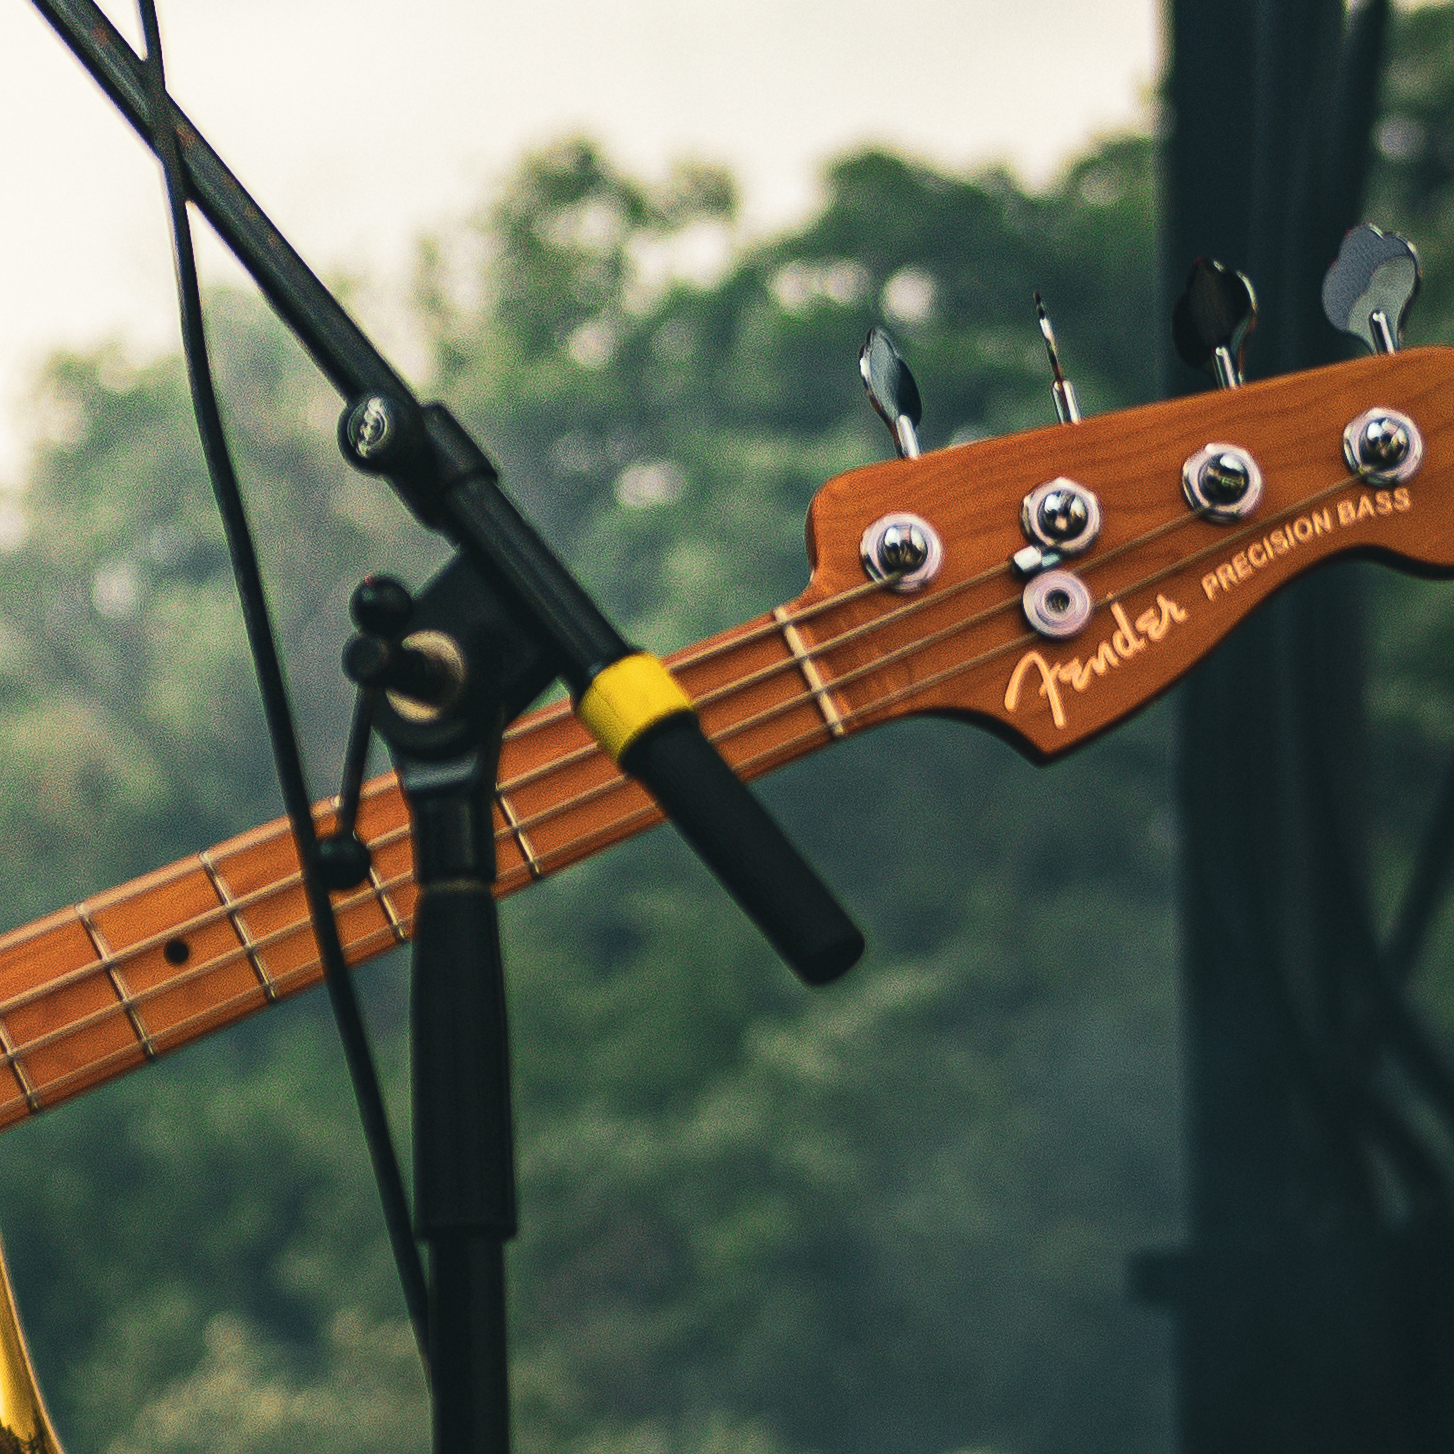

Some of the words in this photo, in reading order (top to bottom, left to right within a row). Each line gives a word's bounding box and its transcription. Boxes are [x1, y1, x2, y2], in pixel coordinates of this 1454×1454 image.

[1200, 507, 1333, 602] PRECISION
[1335, 486, 1412, 528] BASS
[1003, 592, 1188, 730] Fender
